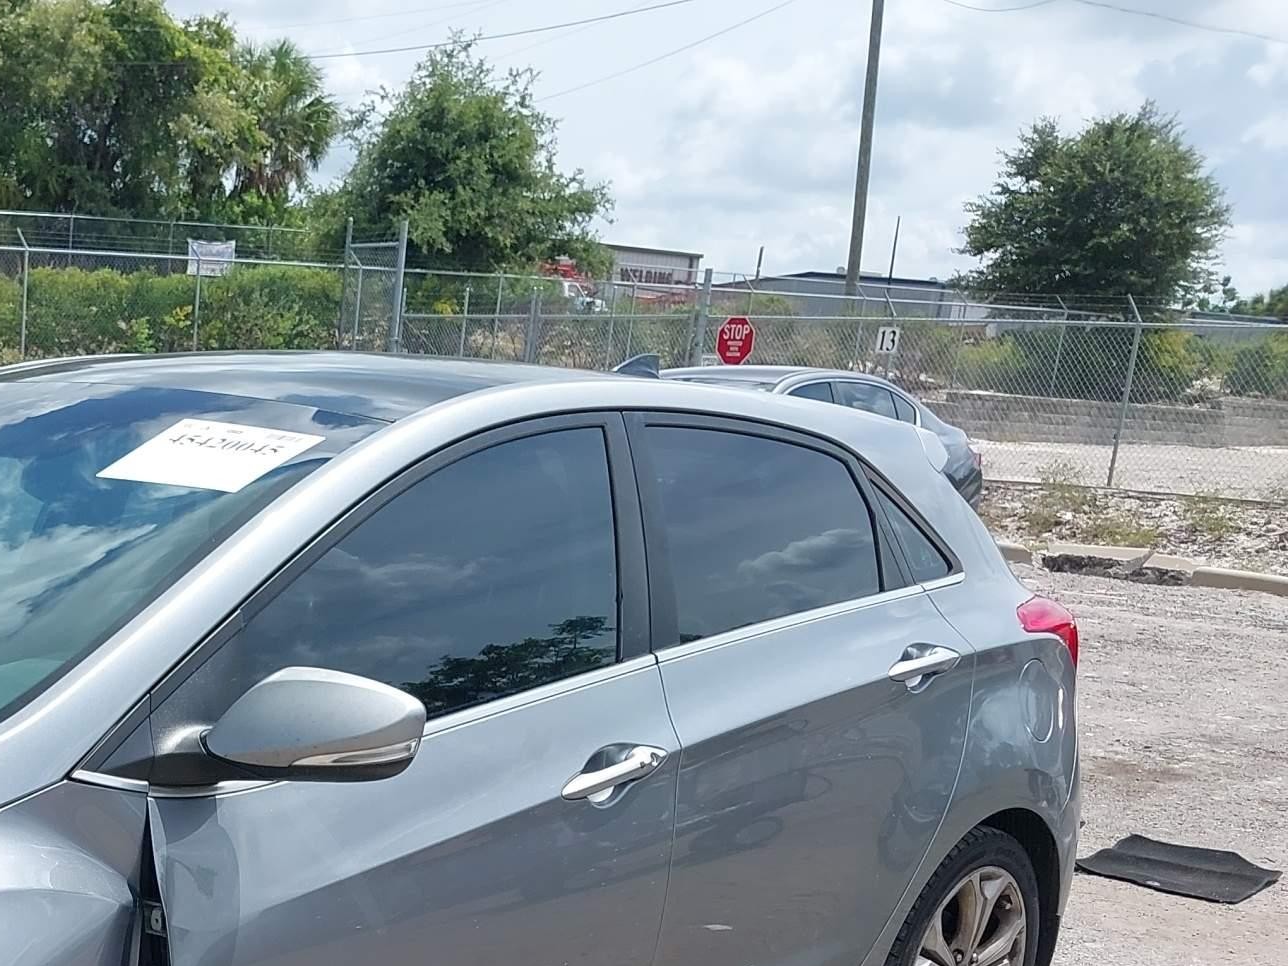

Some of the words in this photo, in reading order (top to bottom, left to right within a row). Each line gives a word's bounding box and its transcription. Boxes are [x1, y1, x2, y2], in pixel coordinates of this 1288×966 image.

[620, 267, 673, 285] WELDING
[722, 324, 751, 340] STOP
[879, 329, 897, 351] 13
